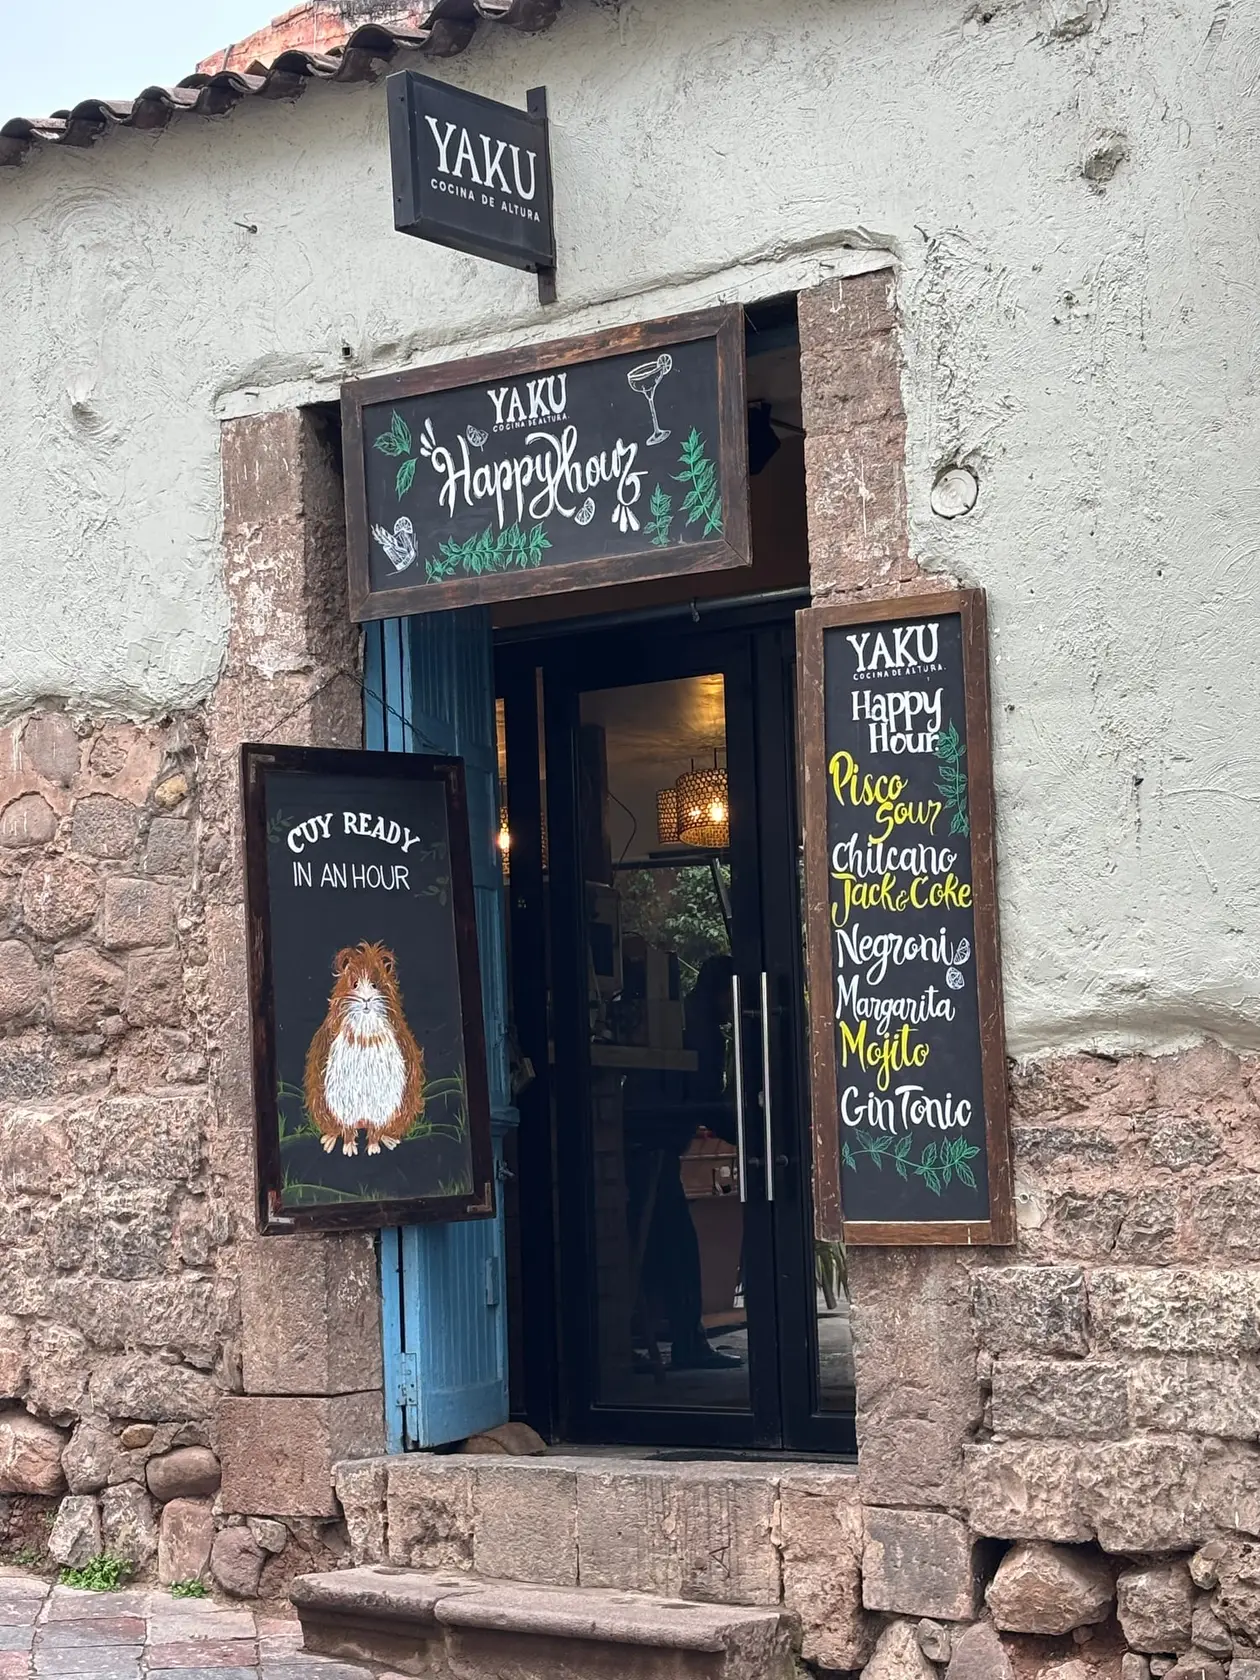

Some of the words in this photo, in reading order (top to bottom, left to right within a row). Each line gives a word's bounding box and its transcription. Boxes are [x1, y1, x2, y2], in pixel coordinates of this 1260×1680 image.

[424, 115, 537, 200] YAKU
[430, 178, 476, 202] COCINA
[481, 193, 495, 208] DE
[501, 200, 541, 223] ALTURA
[487, 372, 567, 424] YAKU
[492, 420, 526, 433] COCINA
[528, 418, 537, 427] DE
[431, 431, 562, 530] Happy
[846, 623, 940, 673] YAKU
[853, 670, 889, 681] COCINA
[851, 688, 944, 733] Happy
[829, 751, 908, 806] Pisco
[287, 813, 333, 853] CUY
[343, 812, 421, 853] READY
[293, 861, 312, 887] IN
[320, 863, 347, 888] AN
[352, 864, 410, 890] HOUR
[831, 872, 897, 928] Jack
[910, 872, 972, 910] Coke
[835, 923, 954, 985] Negroni
[836, 974, 955, 1035] Margarita
[839, 1020, 929, 1091] Mojito
